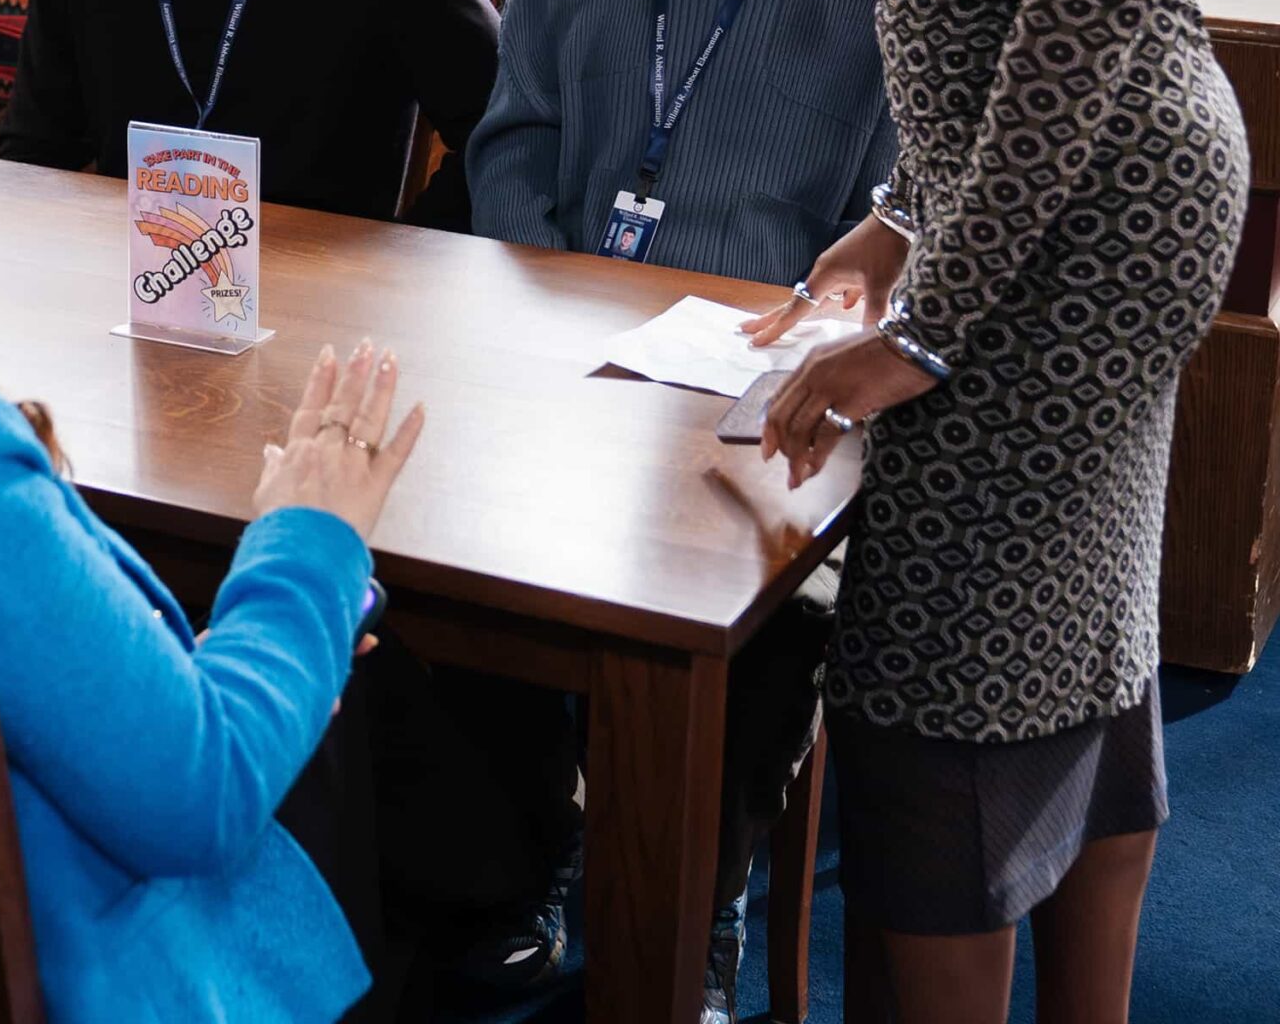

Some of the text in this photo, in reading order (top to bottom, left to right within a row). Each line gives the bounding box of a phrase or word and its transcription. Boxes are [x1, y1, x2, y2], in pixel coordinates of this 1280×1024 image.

[228, 3, 243, 30] Willard
[653, 14, 665, 128] Willard R. Abbott Elementary
[664, 26, 724, 129] Willard R. Abbott Elementary
[143, 149, 241, 179] TAKE PART IN THE
[136, 167, 249, 203] READING
[134, 207, 254, 303] Challenge
[210, 289, 242, 298] PRIZES!
